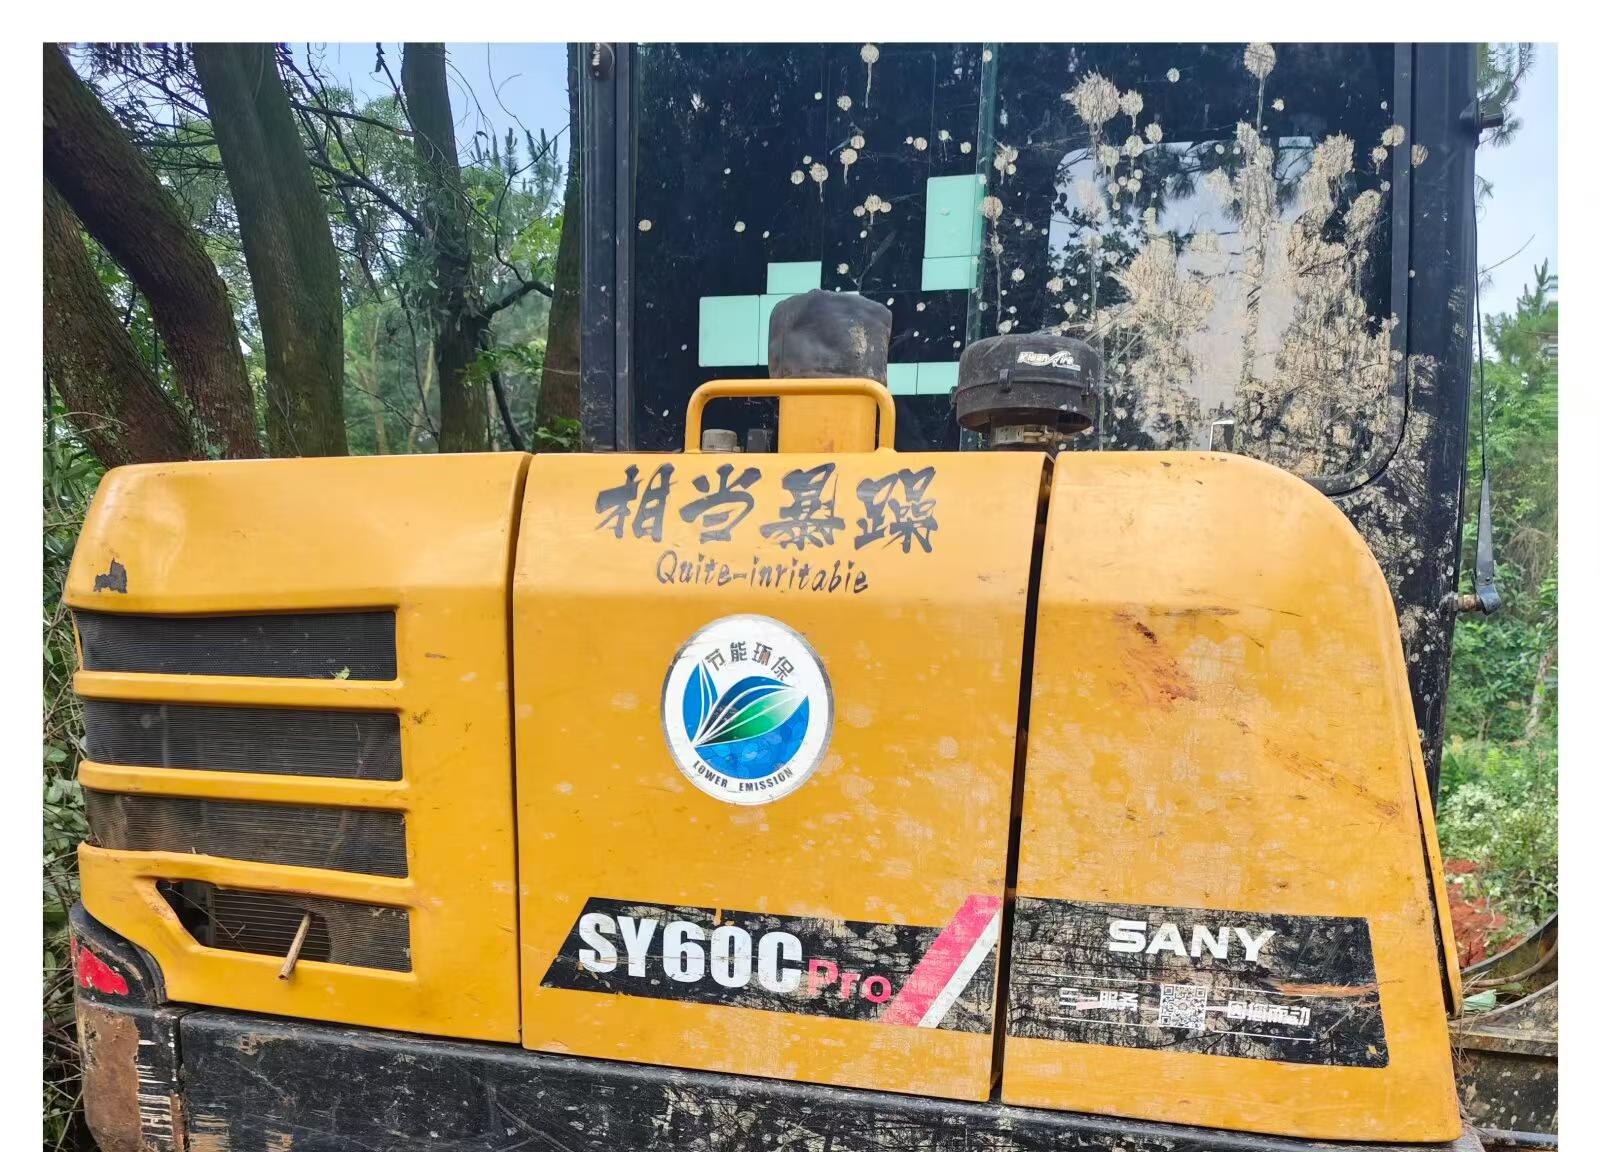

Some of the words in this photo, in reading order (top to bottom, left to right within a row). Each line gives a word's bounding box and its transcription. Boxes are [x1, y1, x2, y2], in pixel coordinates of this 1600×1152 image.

[594, 462, 938, 552] 相当暴躁
[705, 641, 795, 681] 节能环保
[692, 760, 728, 788] LOWER
[739, 767, 793, 791] EMISSION
[578, 912, 803, 993] SY60C
[807, 958, 892, 1004] Pro
[1108, 921, 1276, 962] SANY
